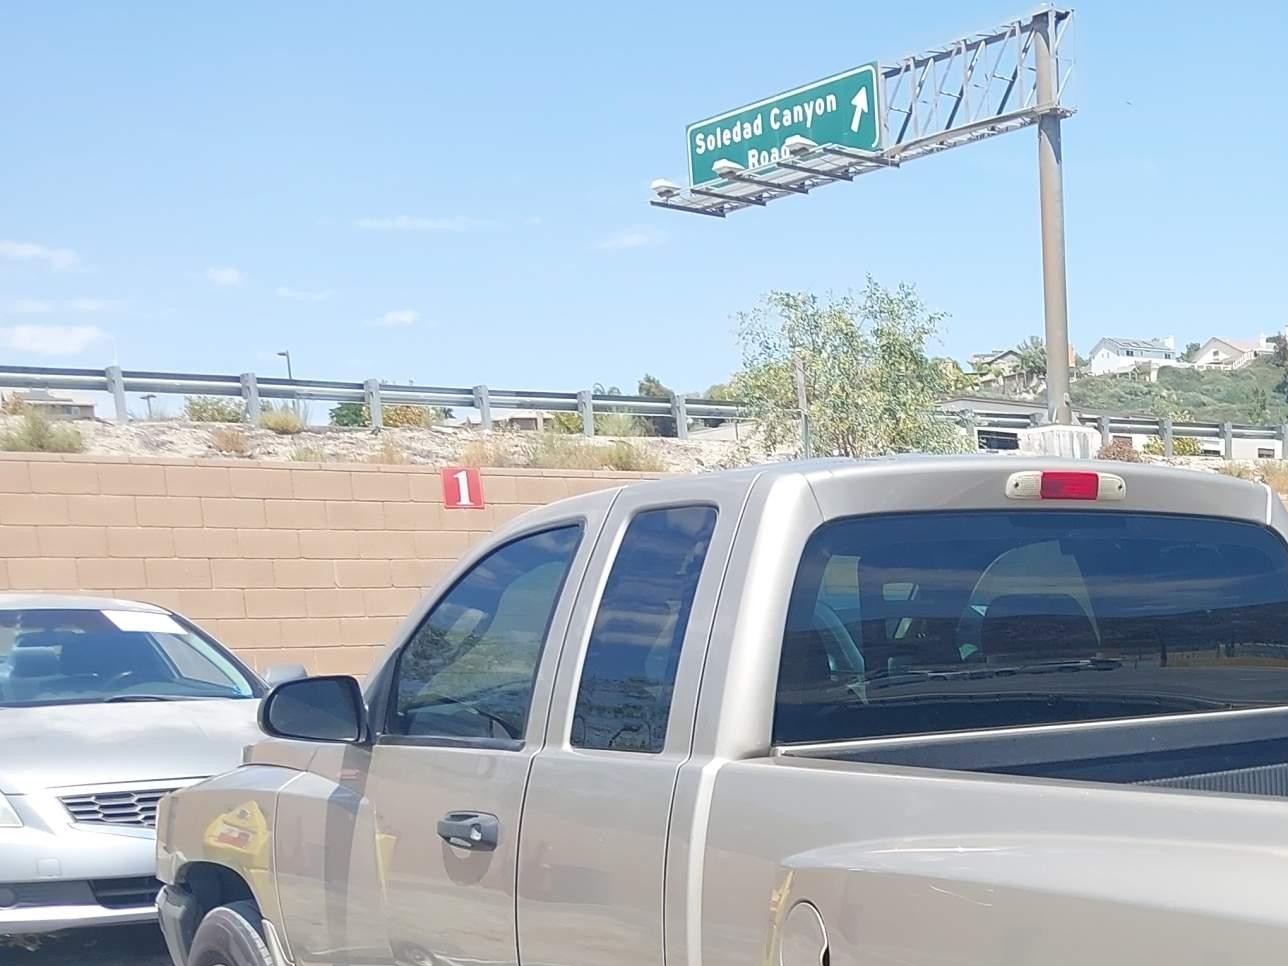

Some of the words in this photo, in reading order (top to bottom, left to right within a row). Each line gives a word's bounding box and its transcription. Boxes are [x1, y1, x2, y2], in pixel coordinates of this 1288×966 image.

[695, 113, 763, 154] Soledad
[769, 93, 837, 130] Canyon
[453, 470, 475, 506] 1
